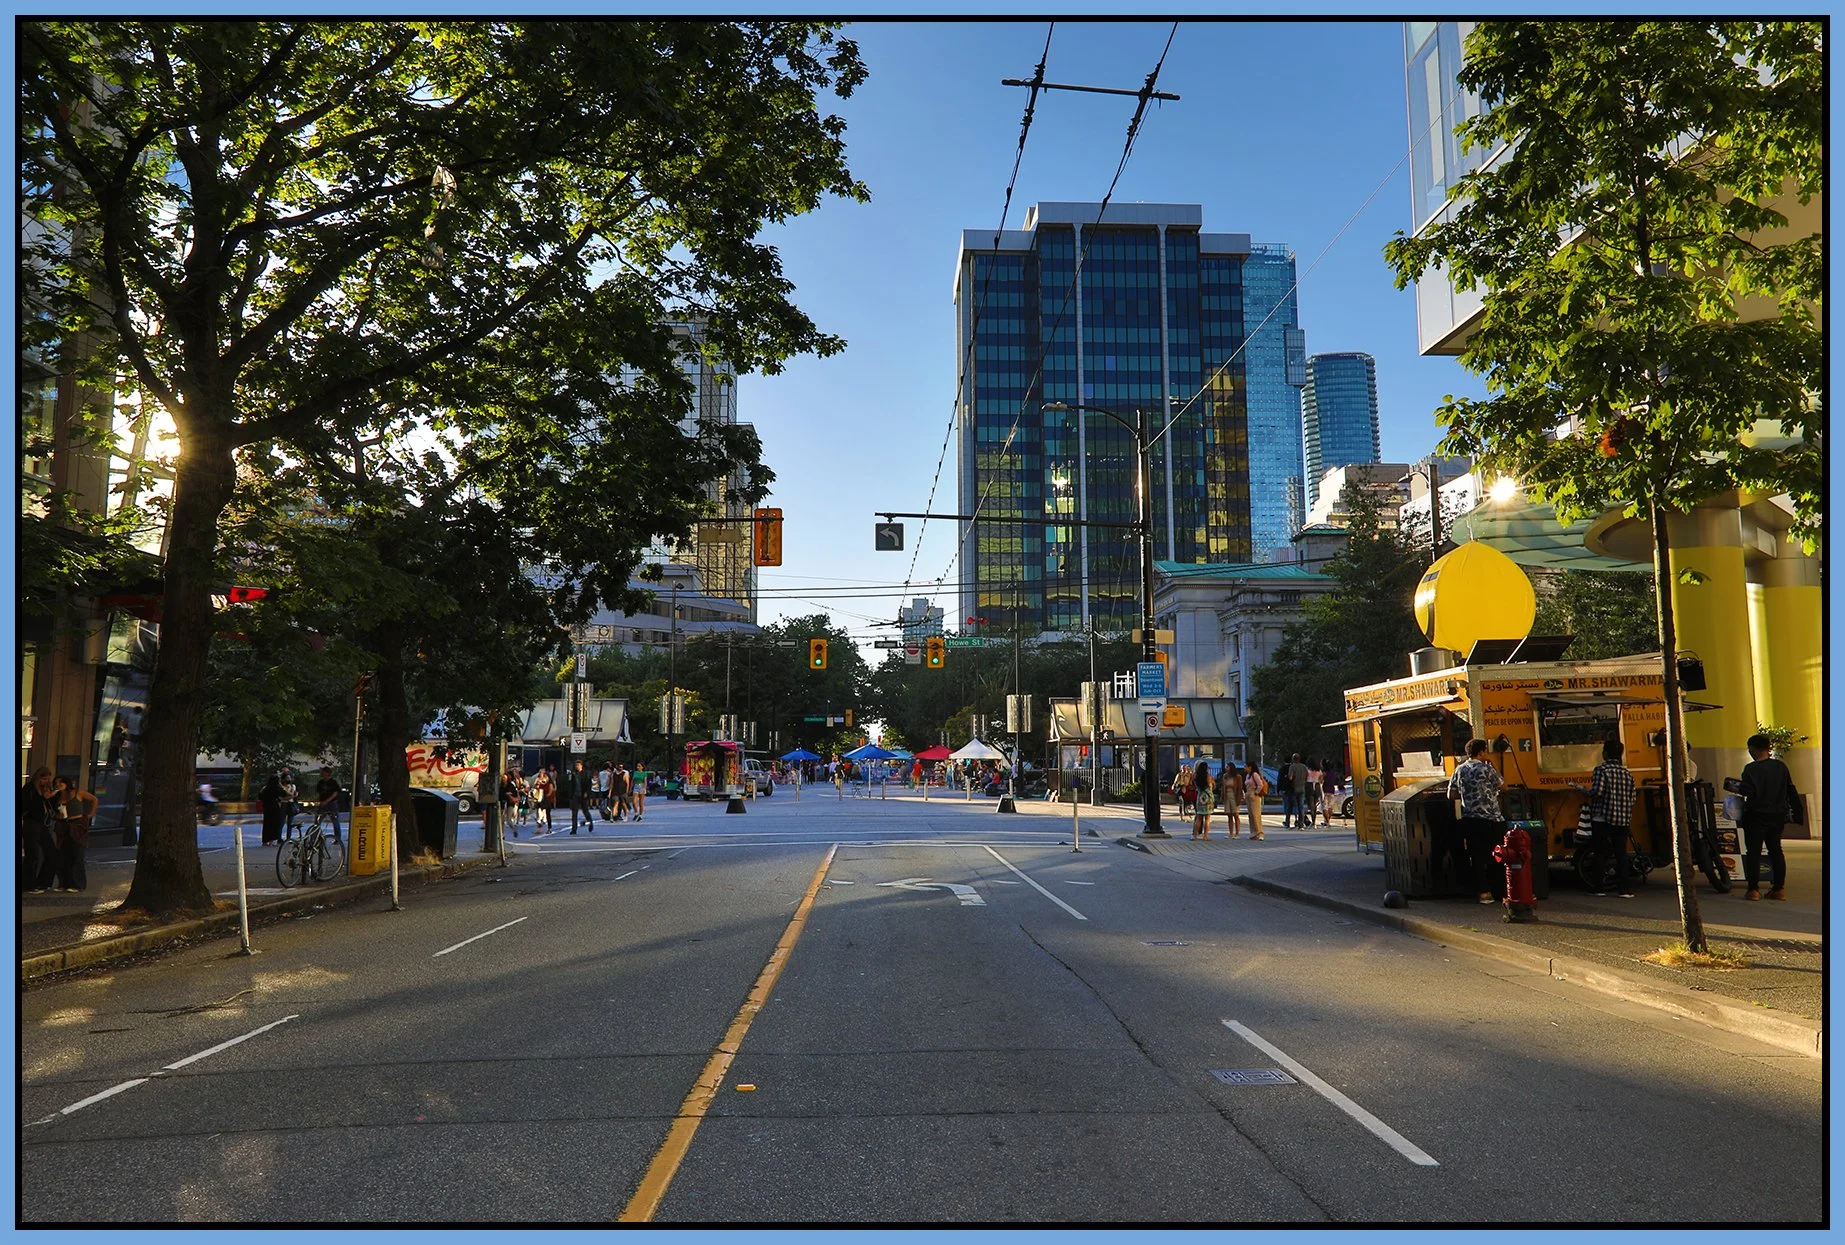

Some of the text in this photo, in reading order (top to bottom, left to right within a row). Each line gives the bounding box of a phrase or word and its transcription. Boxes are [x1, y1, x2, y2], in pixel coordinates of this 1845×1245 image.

[972, 638, 981, 646] St
[1623, 712, 1644, 721] YALLA
[1484, 718, 1500, 727] PEACE
[1500, 718, 1507, 726] BE
[1508, 717, 1522, 726] UPON
[1540, 776, 1564, 785] SERVING
[358, 828, 367, 860] FREE
